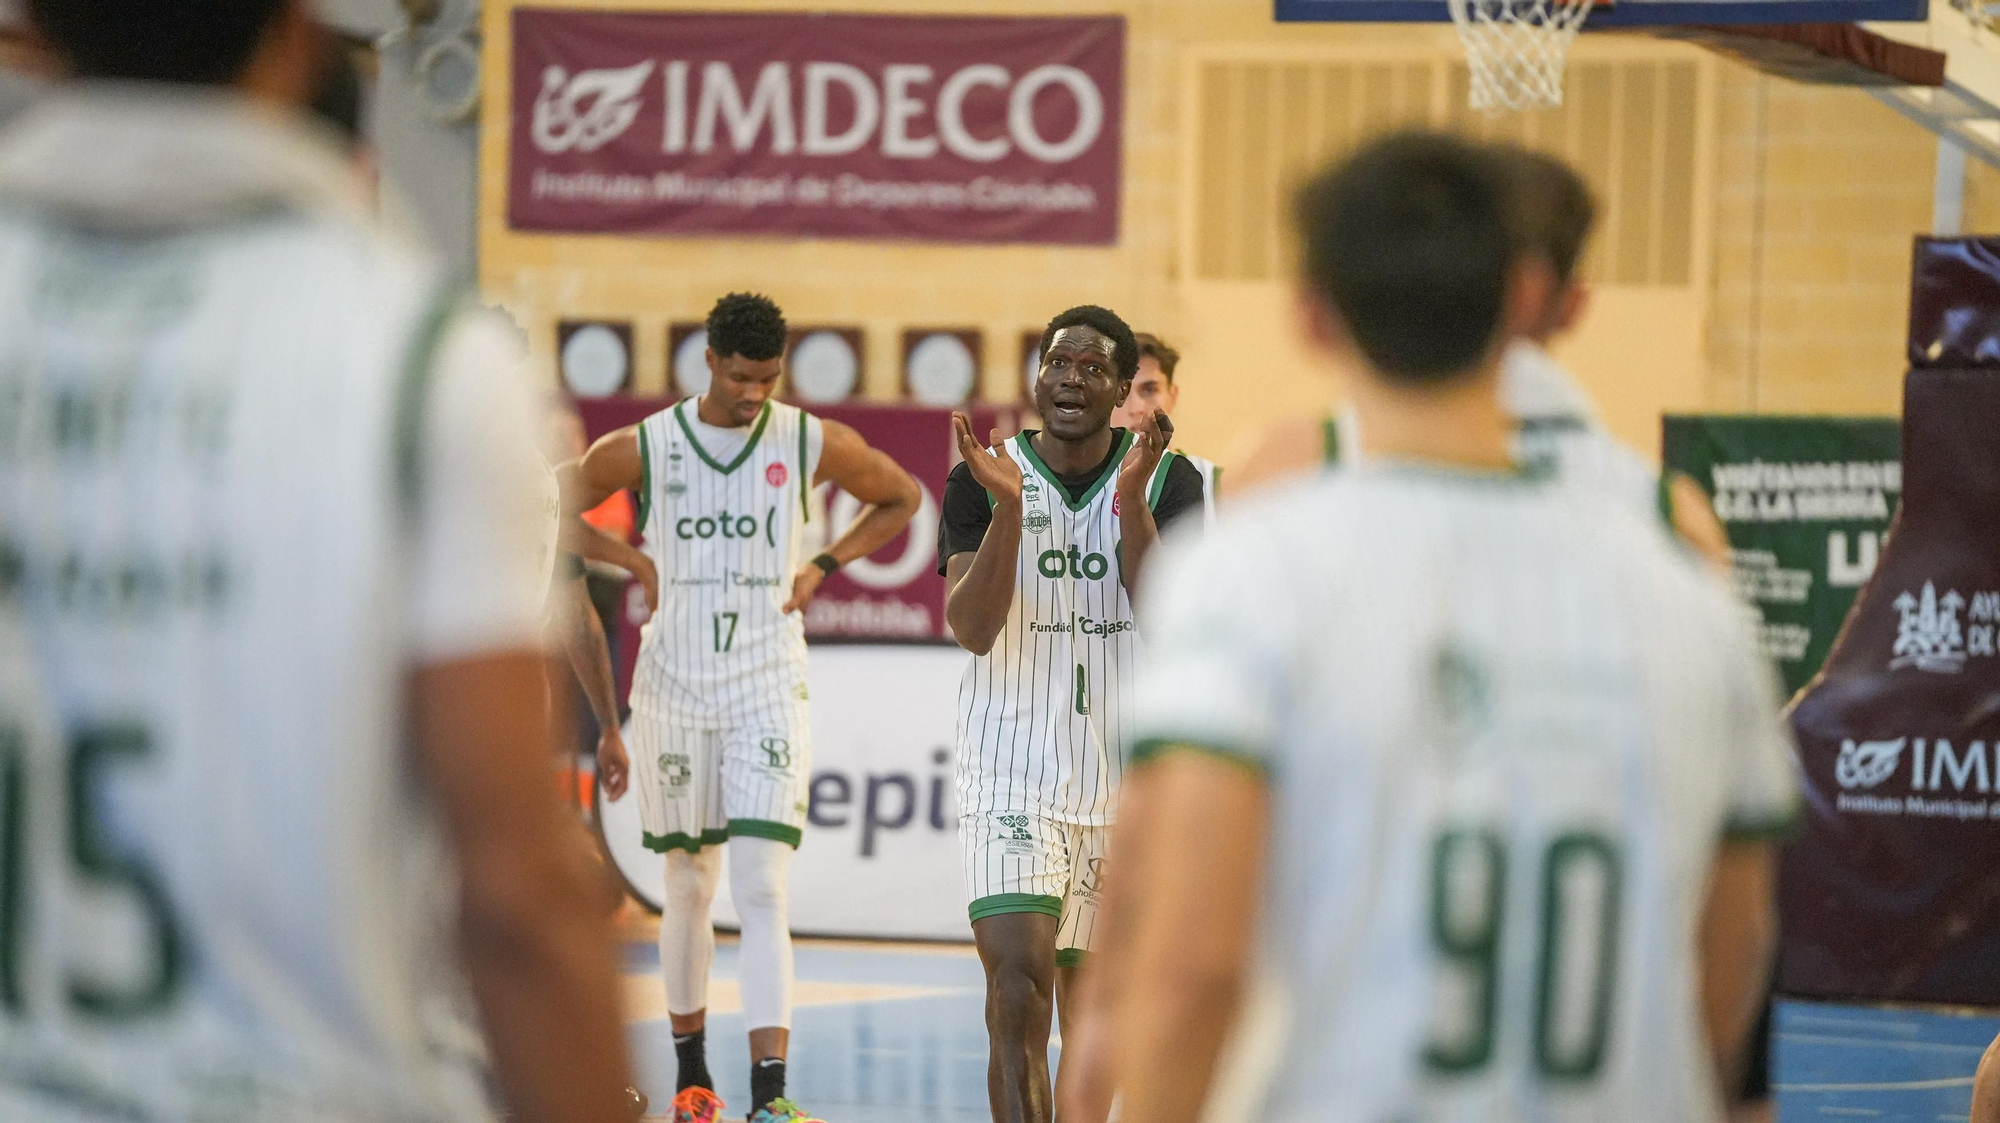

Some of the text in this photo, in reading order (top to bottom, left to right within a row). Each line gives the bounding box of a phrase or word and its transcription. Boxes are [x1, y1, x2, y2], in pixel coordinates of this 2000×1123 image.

[661, 60, 1103, 162] IMDECO
[676, 511, 757, 540] coto
[713, 612, 739, 653] 17
[1422, 826, 1624, 1082] 90
